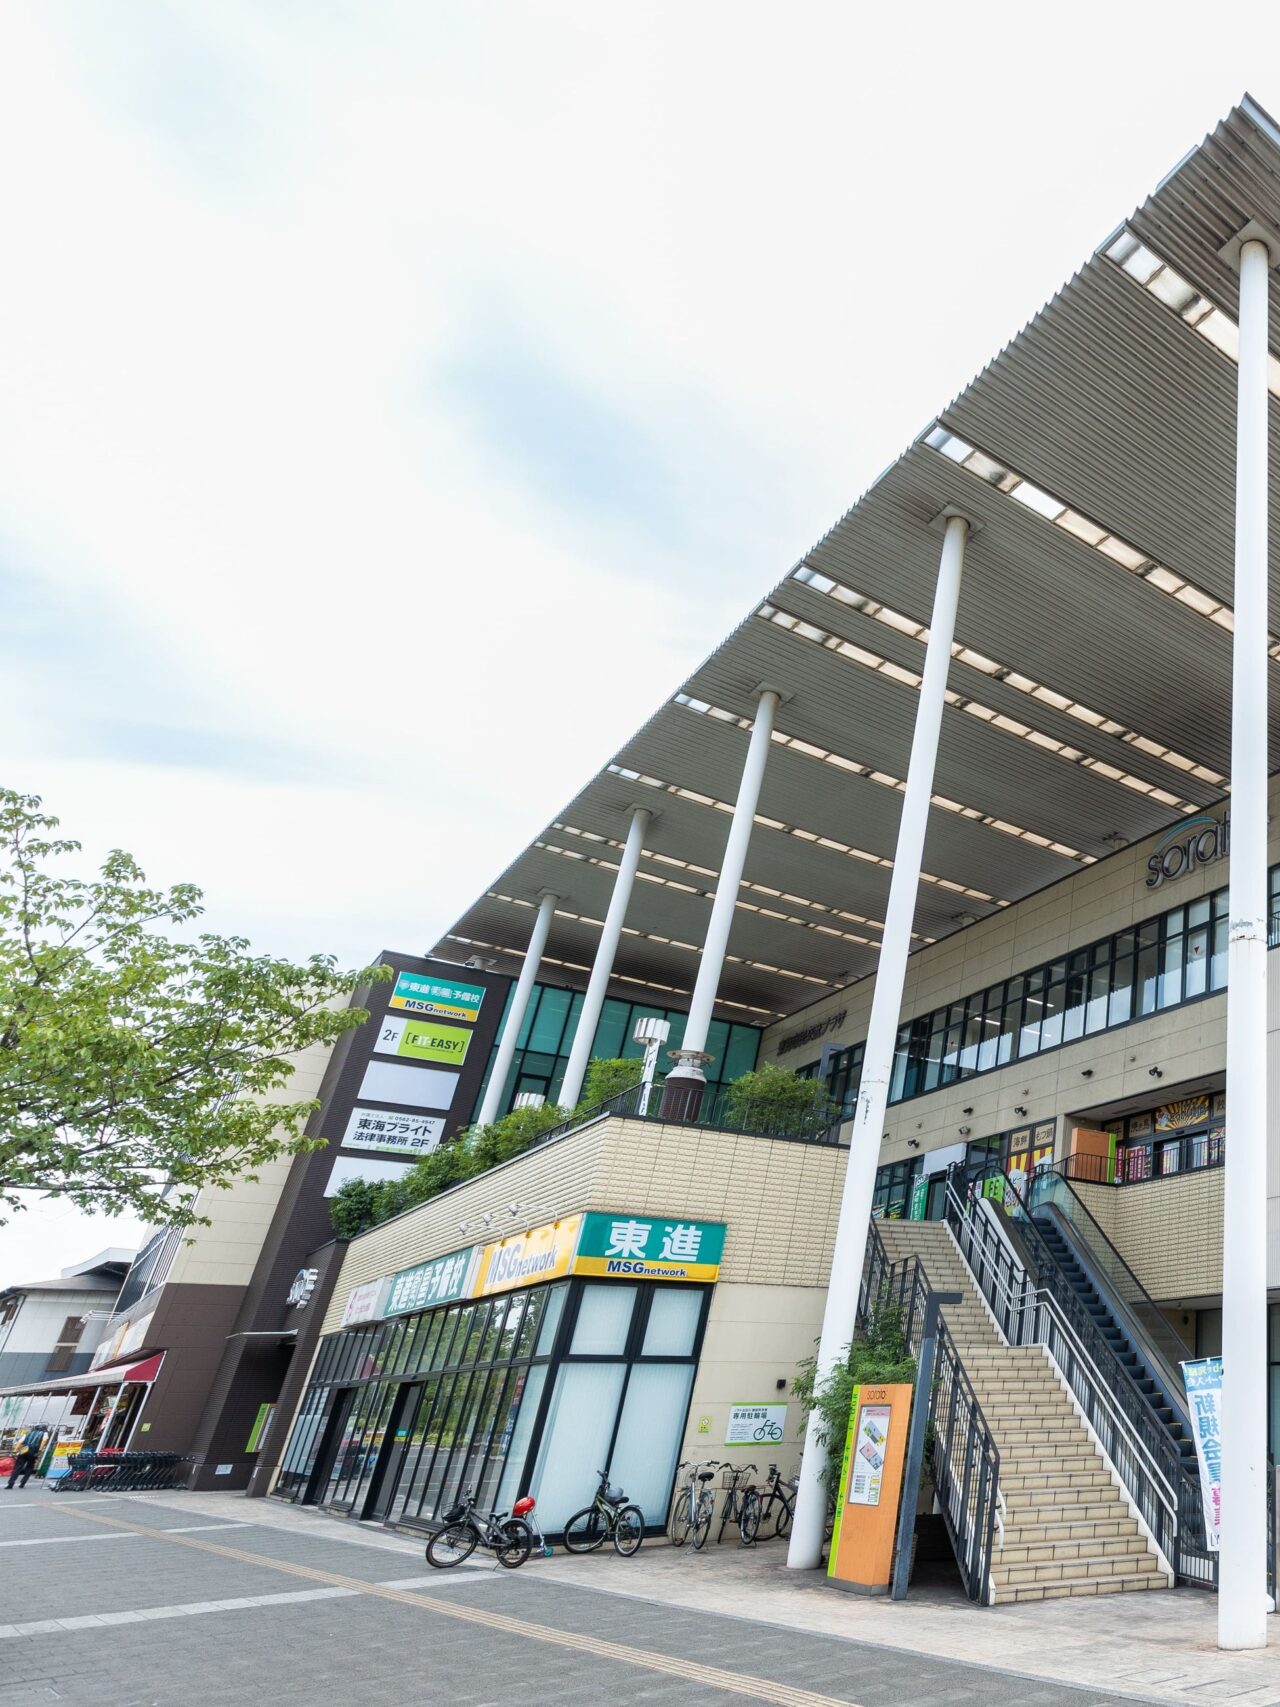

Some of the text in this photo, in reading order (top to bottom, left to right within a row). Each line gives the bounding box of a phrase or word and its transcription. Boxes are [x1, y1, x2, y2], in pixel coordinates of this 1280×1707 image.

[1145, 810, 1231, 889] sorat
[382, 1029, 399, 1042] 2F
[357, 1118, 432, 1136] 東海ブライト
[353, 1131, 430, 1148] 法律事務所 2F
[604, 1221, 703, 1262] 東進
[487, 1242, 558, 1286] MSGnetwork
[607, 1260, 687, 1278] MSGnetwork
